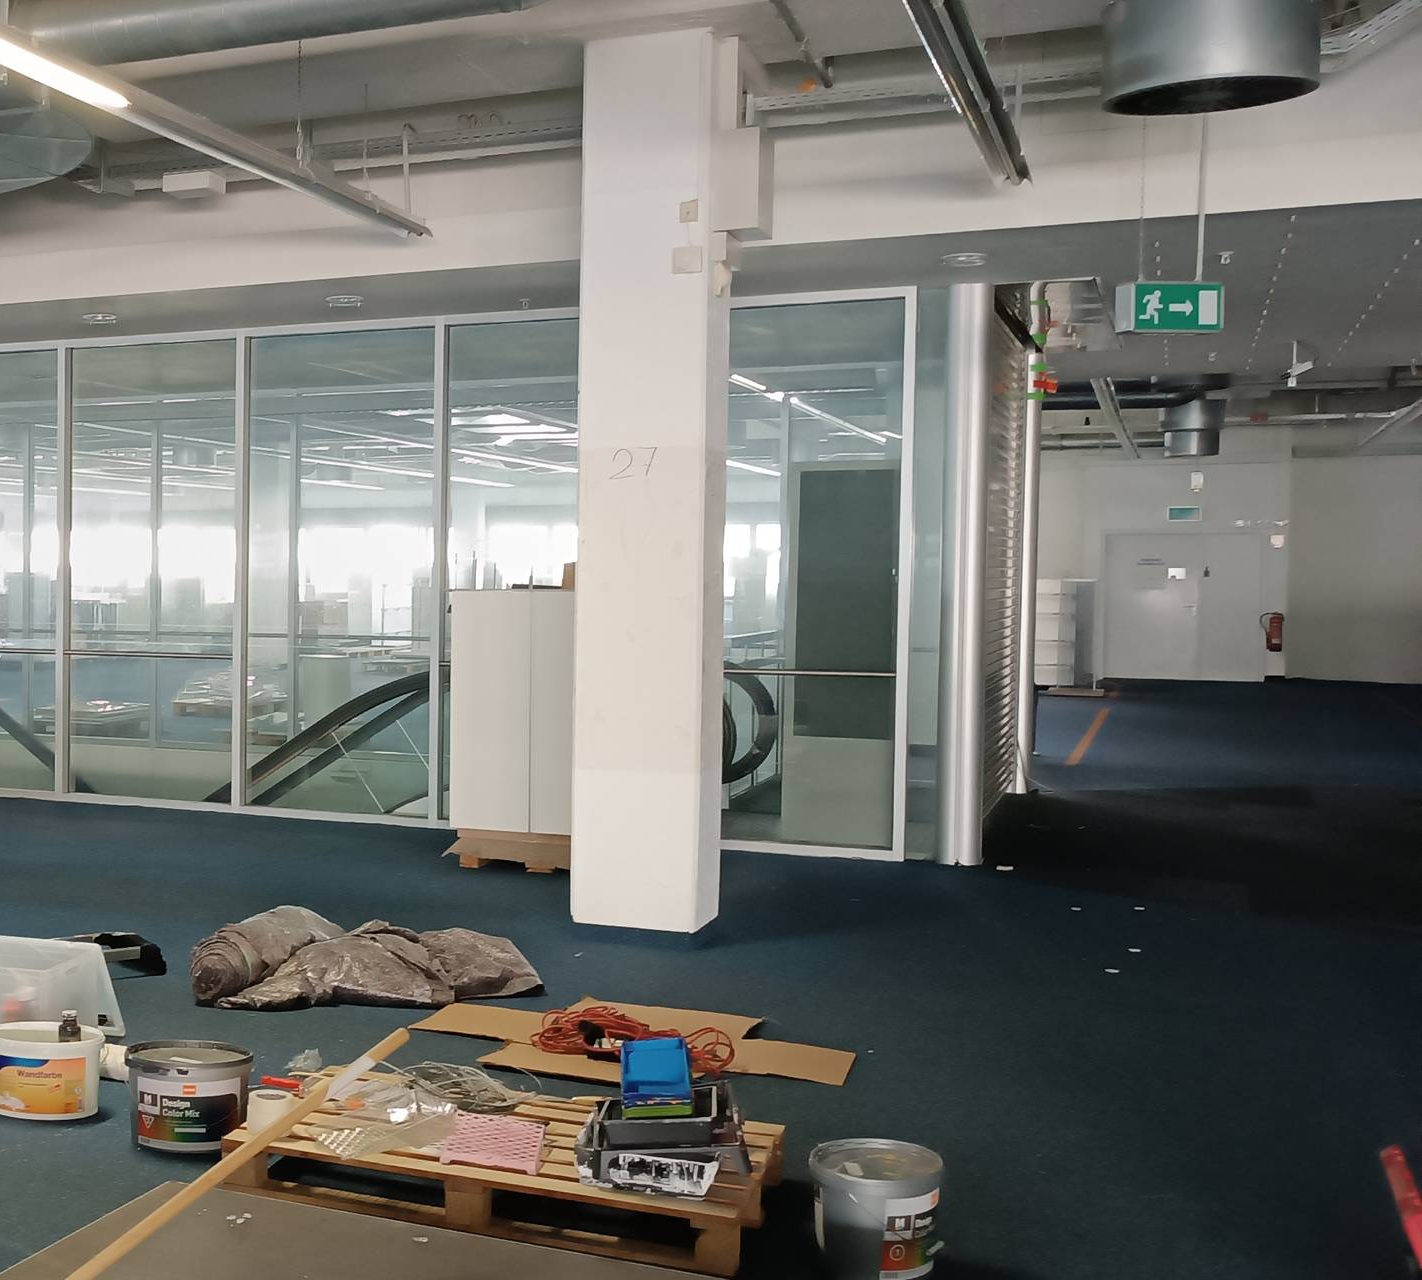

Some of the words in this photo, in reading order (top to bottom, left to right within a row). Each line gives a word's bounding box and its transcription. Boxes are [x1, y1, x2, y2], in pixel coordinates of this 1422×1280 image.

[609, 446, 659, 480] 27
[16, 1069, 63, 1079] Wandfarbe
[162, 1098, 191, 1110] Design
[162, 1109, 184, 1118] Color
[185, 1110, 200, 1118] Mix
